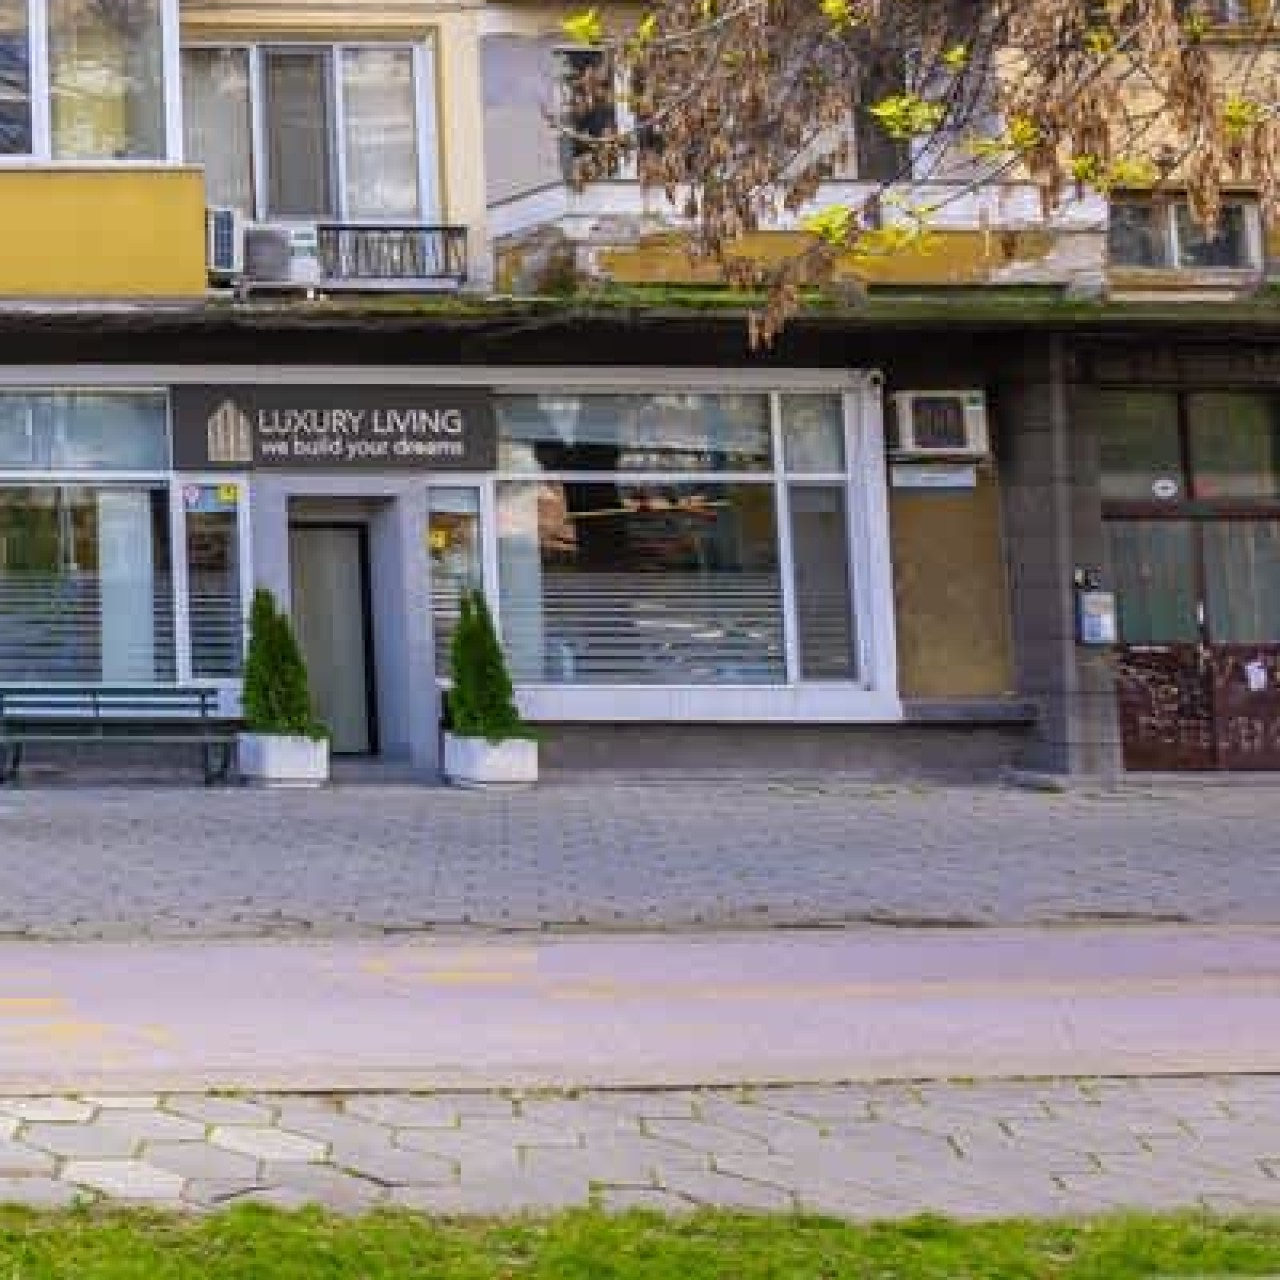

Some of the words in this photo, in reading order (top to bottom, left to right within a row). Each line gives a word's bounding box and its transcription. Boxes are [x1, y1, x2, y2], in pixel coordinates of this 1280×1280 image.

[258, 409, 365, 433] LUXURY
[372, 409, 462, 433] LIVING
[262, 440, 288, 455] we
[293, 435, 342, 455] build
[346, 439, 389, 459] your
[393, 435, 464, 455] dreams
